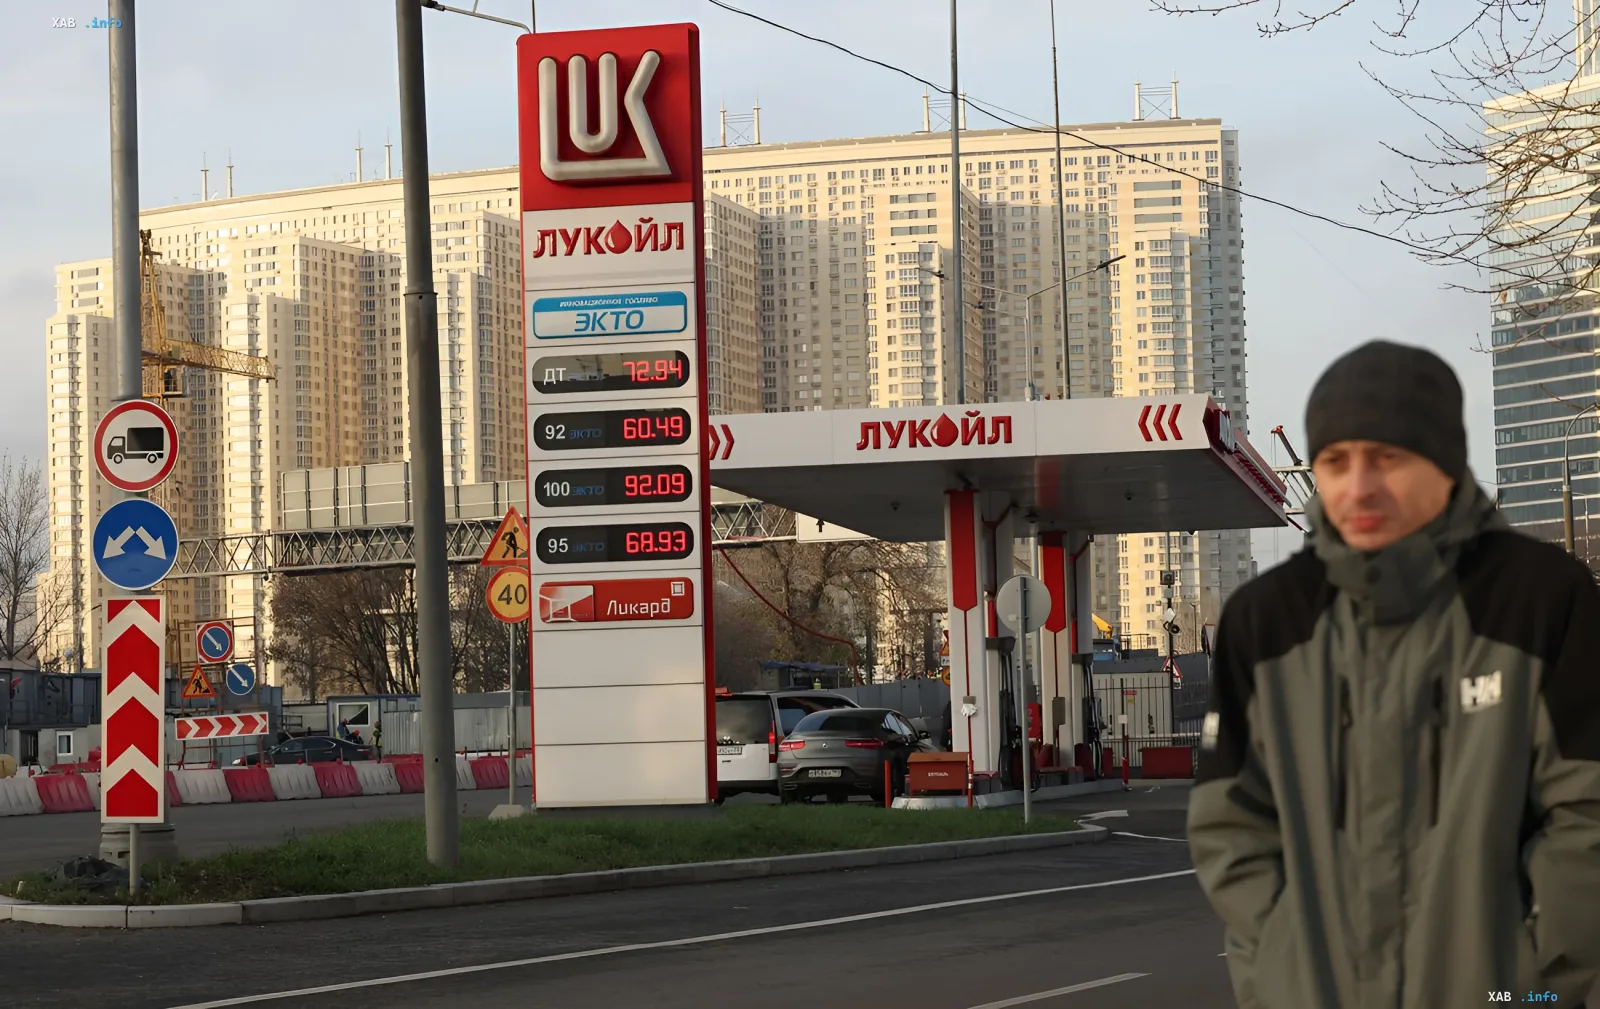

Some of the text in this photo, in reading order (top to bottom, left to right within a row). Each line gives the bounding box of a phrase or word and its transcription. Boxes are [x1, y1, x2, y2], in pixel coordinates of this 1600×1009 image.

[533, 217, 685, 259] ЛУКОЙЛ
[574, 310, 645, 332] ЭКТО
[543, 359, 683, 385] ДТ 72.94
[545, 424, 566, 440] 92
[623, 416, 684, 440] 60.49
[856, 410, 1012, 451] ЛУКОЙЛ
[543, 482, 570, 497] 100
[625, 473, 685, 496] 92.09
[547, 538, 569, 553] 95
[626, 530, 686, 554] 68.93
[497, 583, 527, 605] 40
[607, 598, 671, 618] Ликард
